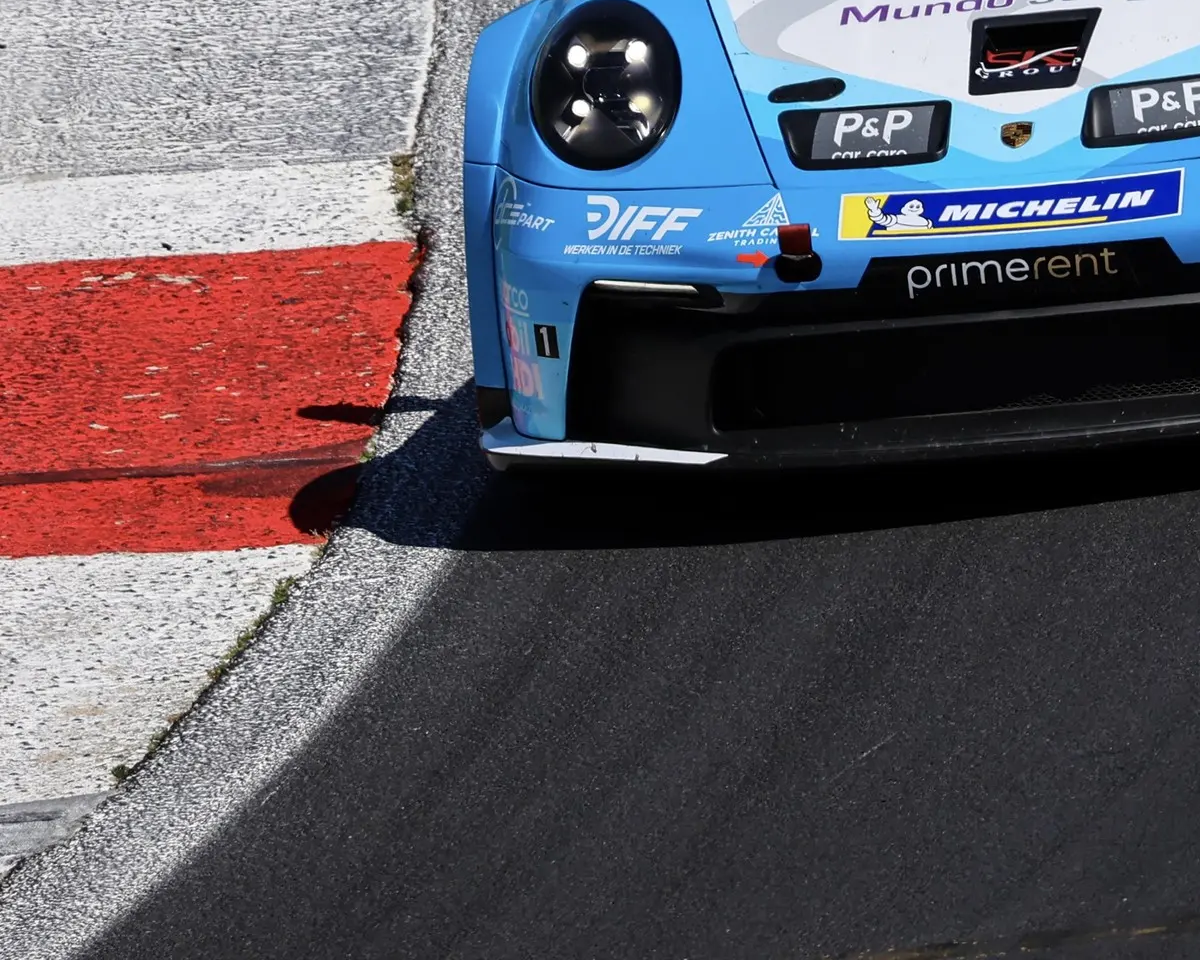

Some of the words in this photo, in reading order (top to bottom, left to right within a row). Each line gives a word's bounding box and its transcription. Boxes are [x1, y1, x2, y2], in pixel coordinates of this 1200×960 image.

[974, 57, 1082, 79] GROUP
[833, 110, 913, 147] P&P
[587, 194, 704, 241] DIFF
[938, 188, 1155, 222] MICHELIN
[707, 228, 756, 242] ZENITH
[734, 238, 778, 247] TRADIN
[563, 244, 607, 256] WERKEN
[619, 244, 633, 256] DE
[634, 244, 683, 256] TECHNIEK
[906, 247, 1119, 300] primerent
